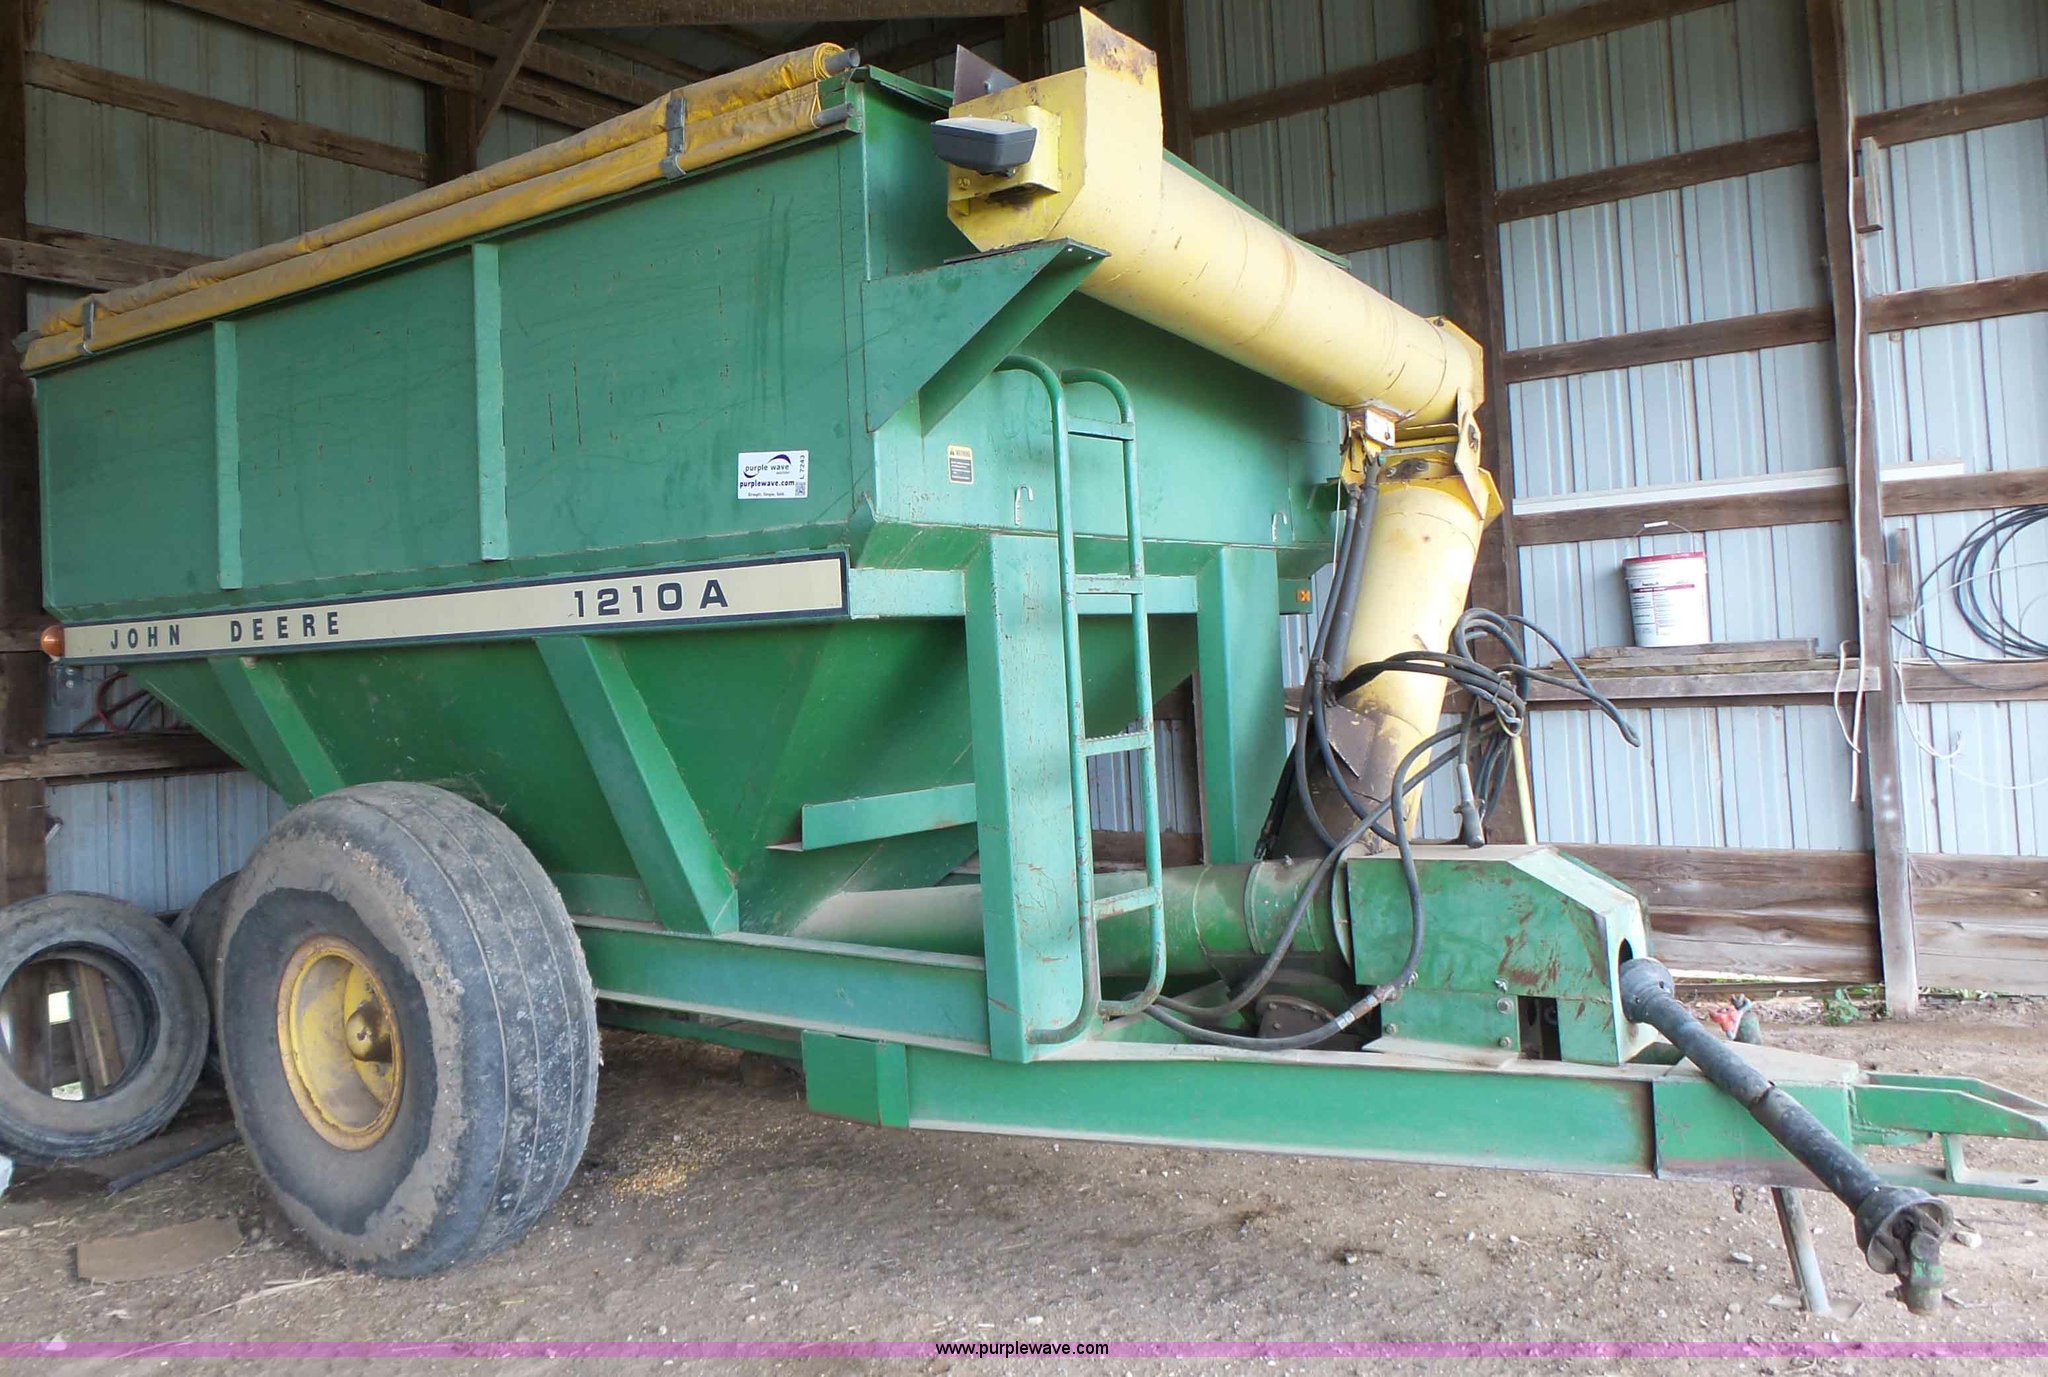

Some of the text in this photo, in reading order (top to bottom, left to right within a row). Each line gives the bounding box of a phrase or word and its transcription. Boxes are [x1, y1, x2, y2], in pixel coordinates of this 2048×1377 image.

[745, 464, 768, 472] purple
[740, 480, 795, 489] purplewave.com
[110, 624, 180, 650] JOHN
[230, 611, 339, 642] DEERE
